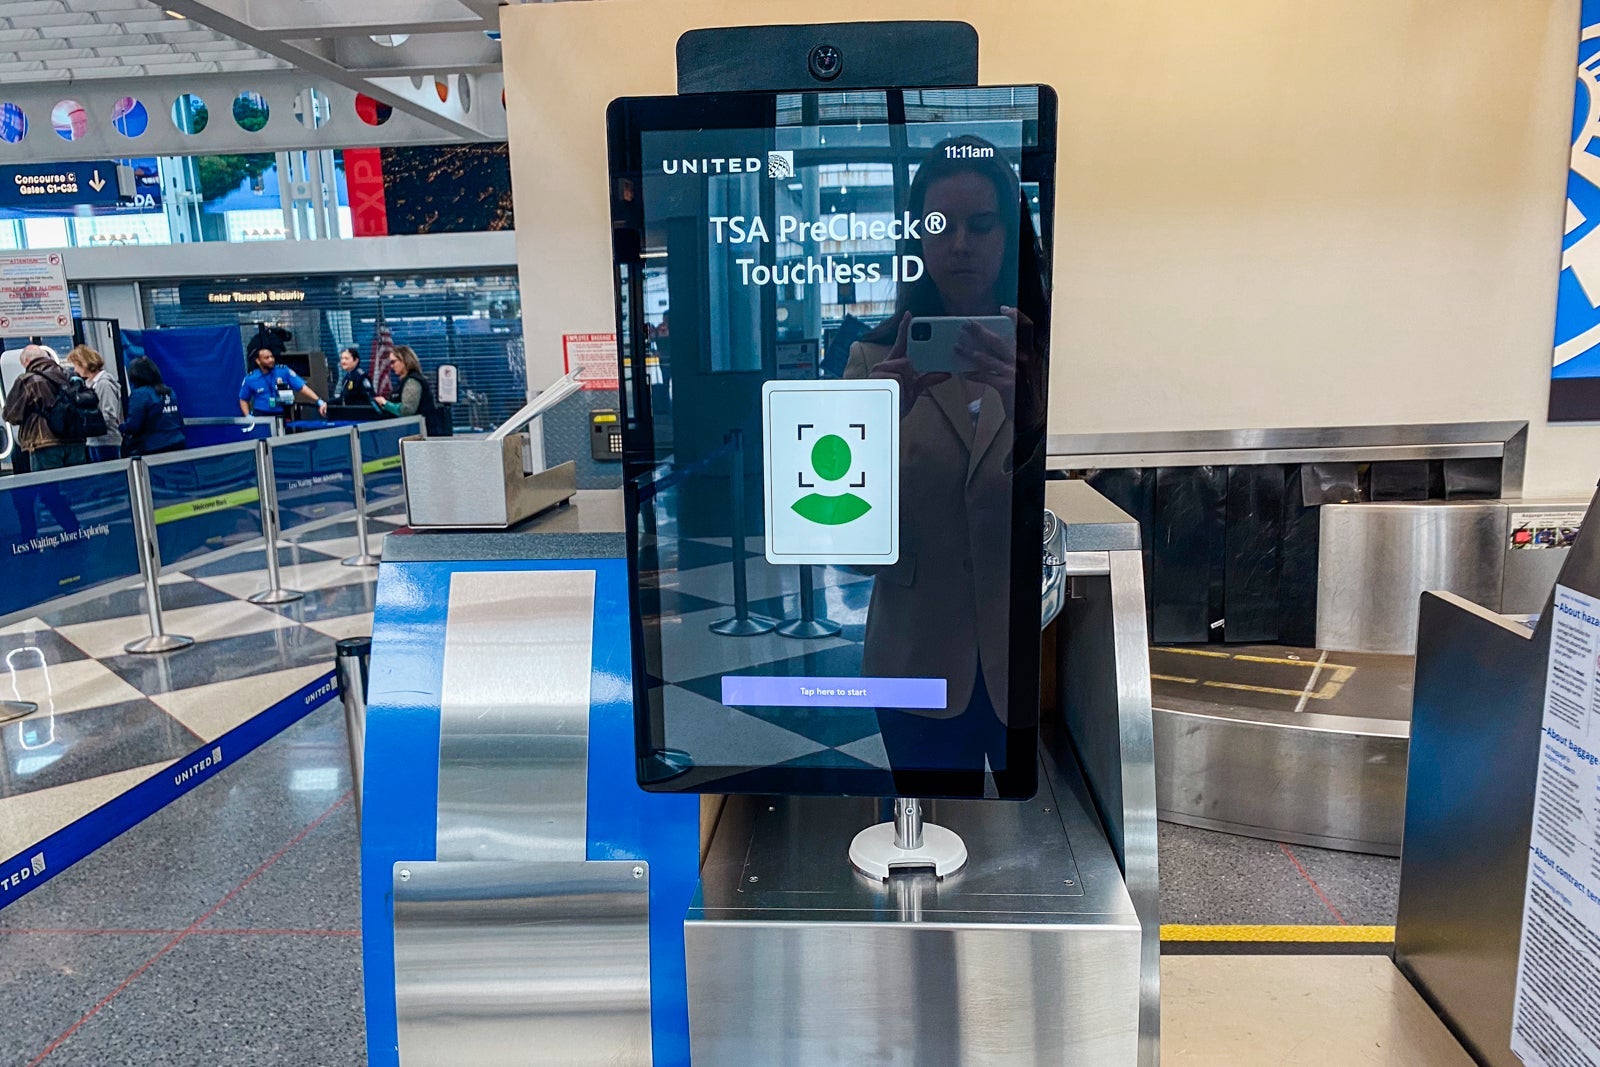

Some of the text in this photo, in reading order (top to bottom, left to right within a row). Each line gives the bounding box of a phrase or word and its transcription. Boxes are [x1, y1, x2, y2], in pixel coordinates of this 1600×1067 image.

[944, 145, 994, 159] 11:11am
[662, 157, 762, 175] UNITED
[15, 172, 75, 185] Concourse C
[20, 183, 78, 195] Gates C1-C32
[709, 215, 770, 244] TSA
[735, 254, 925, 286] Touchless ID
[208, 290, 305, 303] Enter Through Security
[12, 543, 30, 555] Less
[60, 530, 78, 543] More
[78, 523, 110, 540] Exploring
[1559, 602, 1581, 619] About
[305, 683, 331, 705] UNITED
[799, 687, 867, 697] Tap here to start
[1546, 727, 1568, 746] About
[1568, 739, 1599, 766] baggage
[174, 756, 212, 786] UNITED
[1535, 847, 1555, 869] About
[1556, 865, 1586, 893] contract
